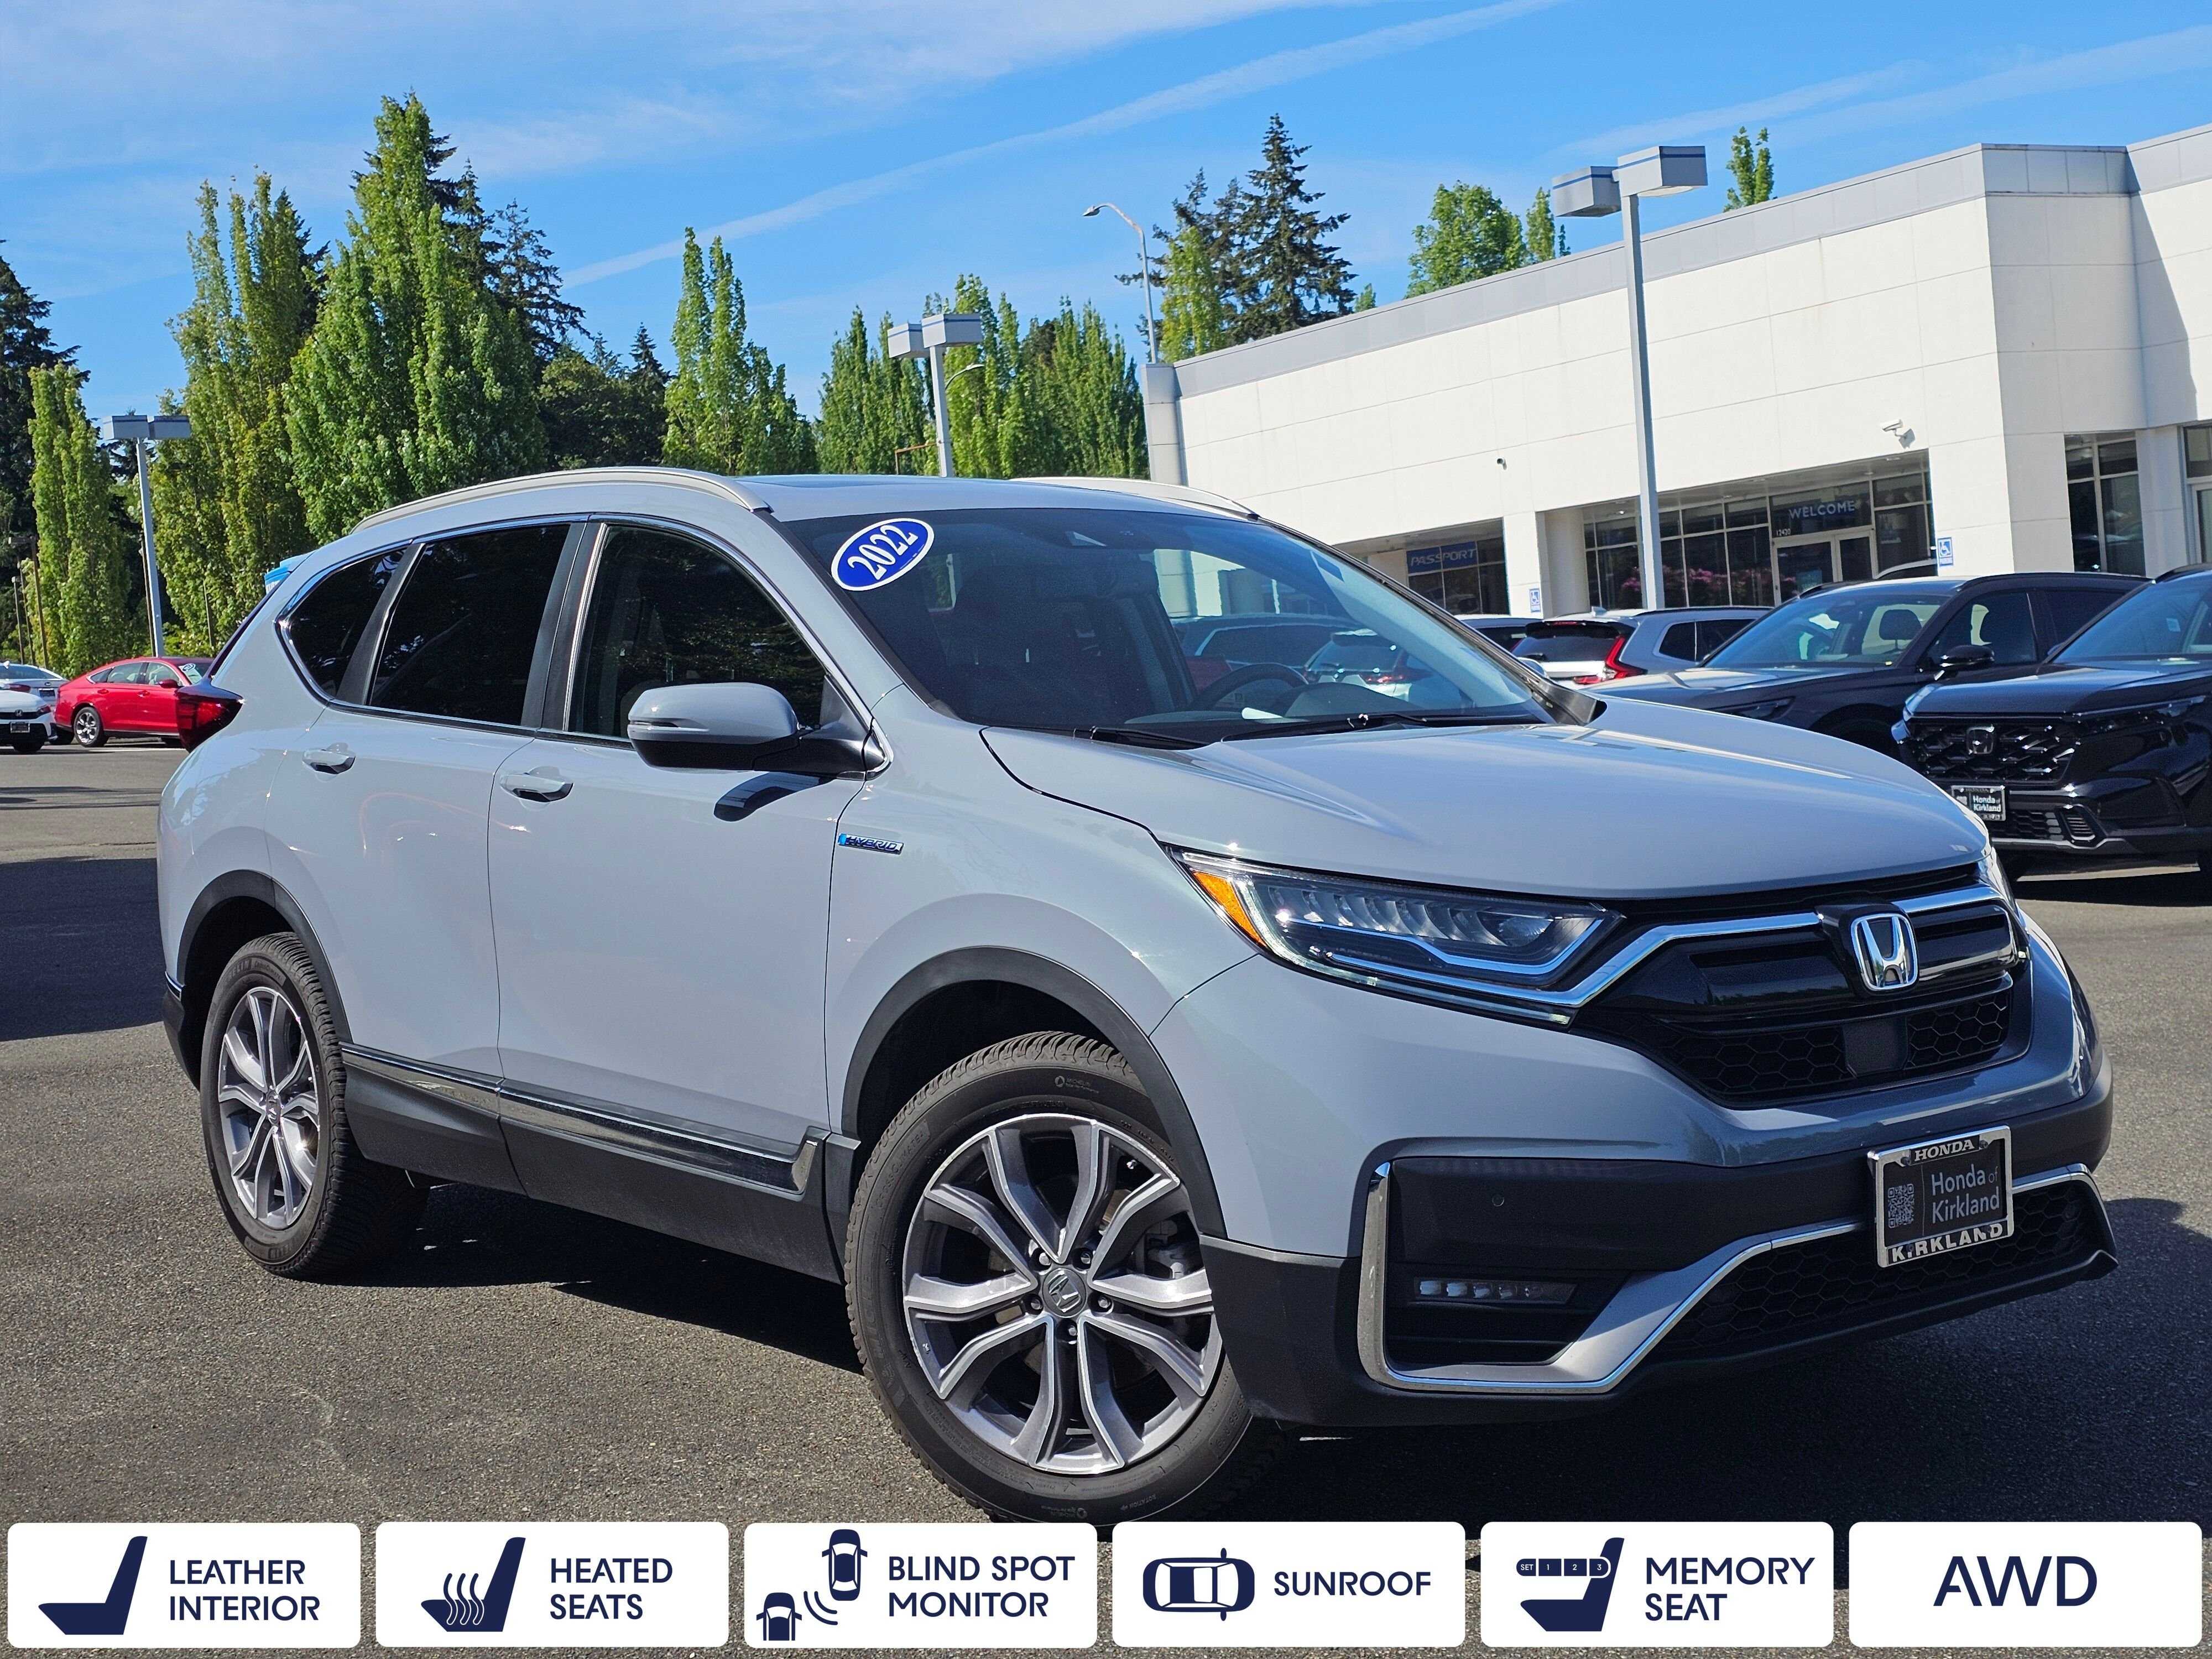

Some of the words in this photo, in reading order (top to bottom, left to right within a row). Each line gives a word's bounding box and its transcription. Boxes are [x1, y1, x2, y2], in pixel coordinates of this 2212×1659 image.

[1789, 501, 1855, 519] WELCOME
[847, 525, 919, 580] 2022
[1410, 549, 1477, 567] PASSPORT
[846, 836, 898, 852] HYBRID
[1914, 1139, 1975, 1162] HONDA
[1932, 1164, 1986, 1196] Honda
[1988, 1166, 1999, 1183] of
[1932, 1186, 2000, 1224] Kirkland
[1129, 1494, 1157, 1509] ROTATION
